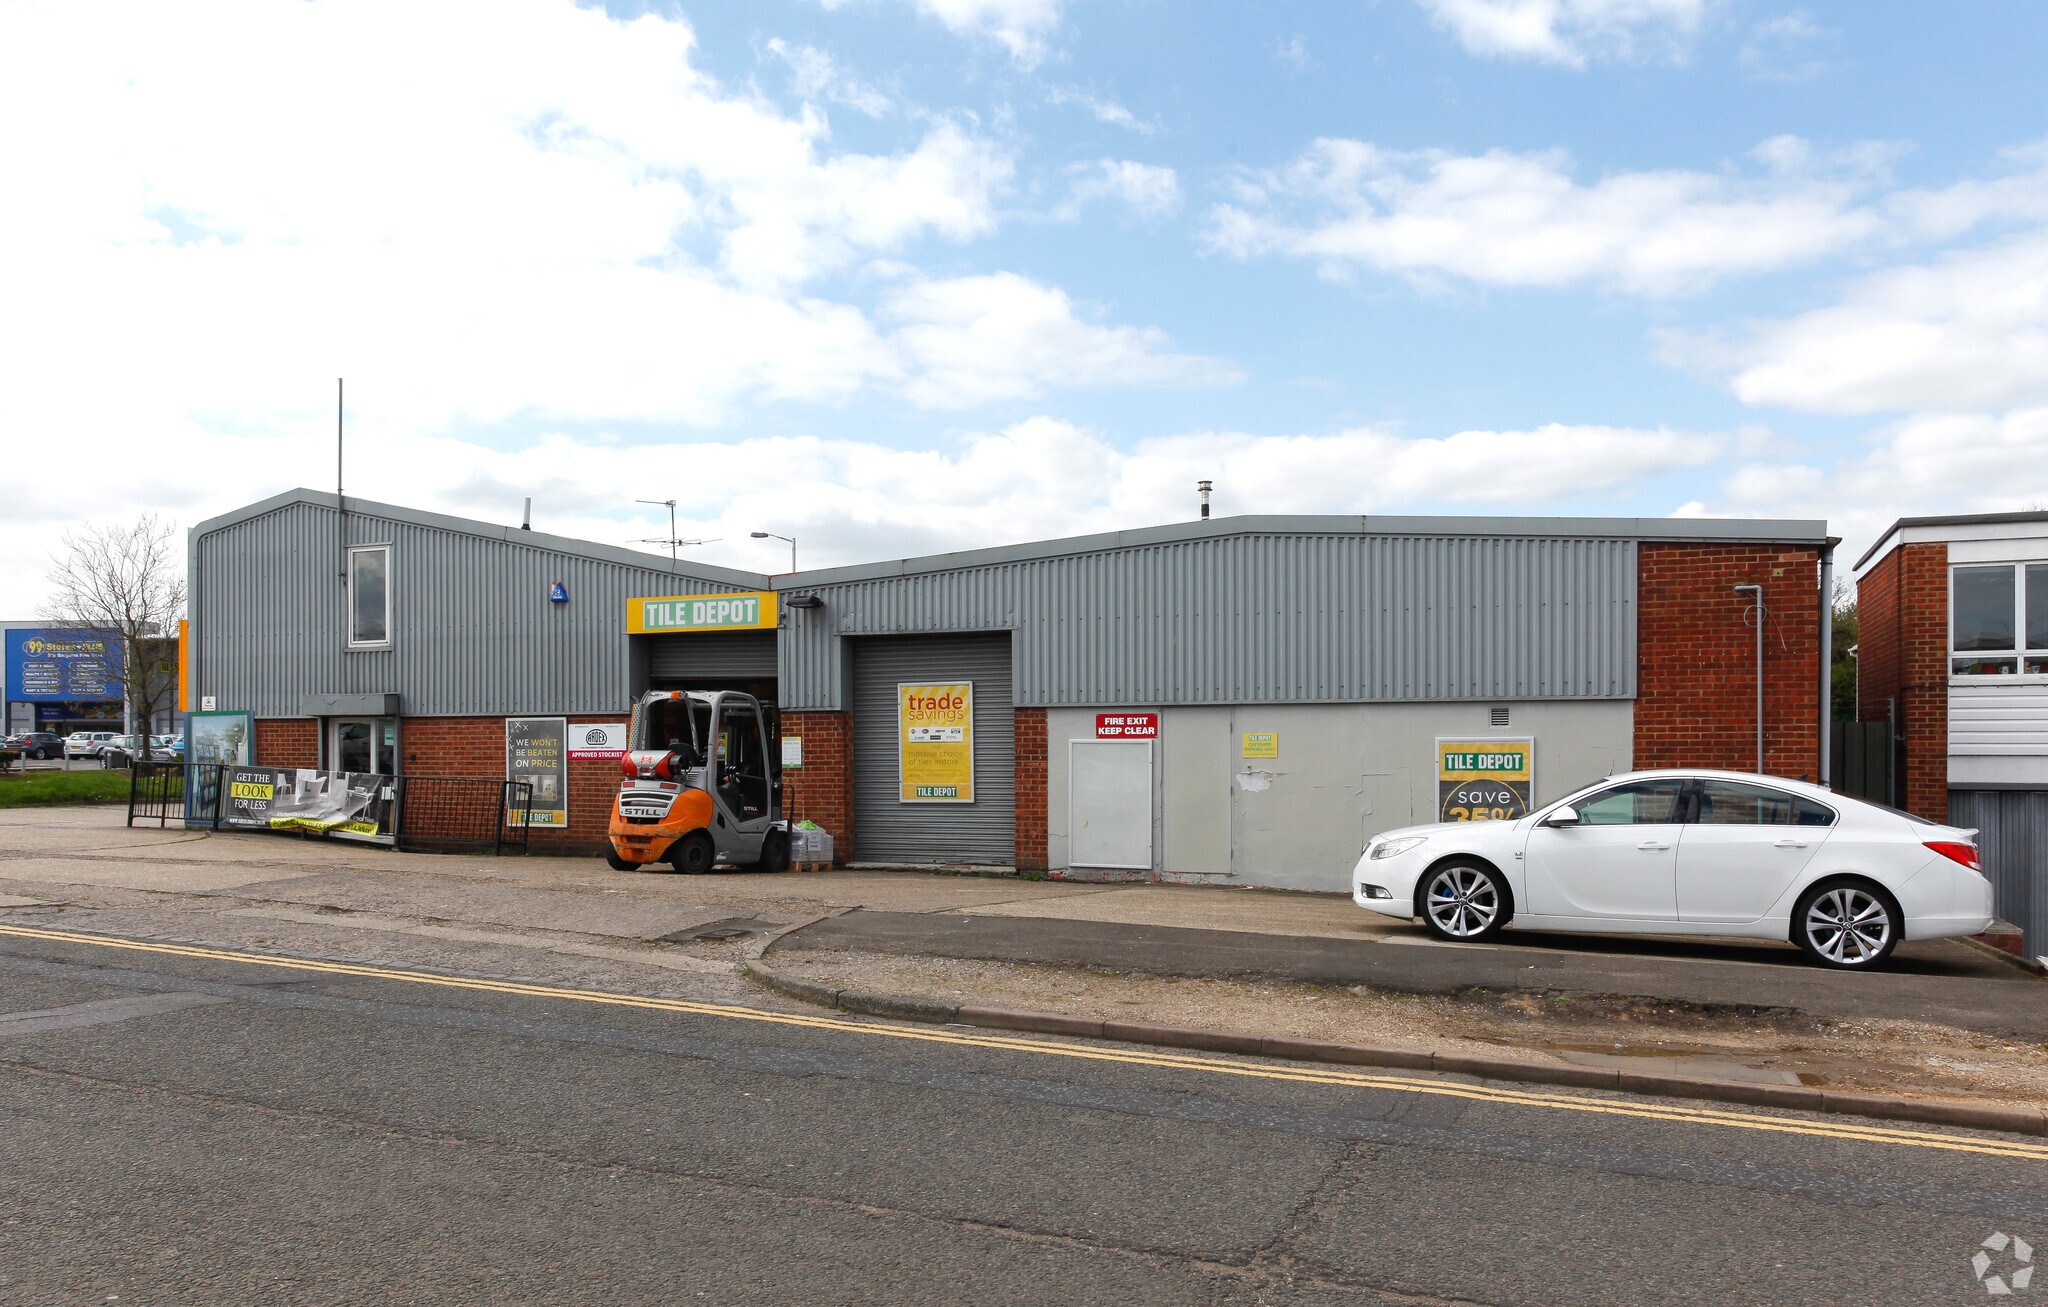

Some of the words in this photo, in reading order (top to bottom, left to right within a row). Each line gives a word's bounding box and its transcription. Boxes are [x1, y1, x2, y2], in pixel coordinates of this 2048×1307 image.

[646, 602, 686, 627] TILE
[692, 599, 757, 624] DEPOT
[908, 693, 964, 711] trade
[908, 709, 964, 723] savings
[1105, 718, 1125, 726] FIRE
[1127, 717, 1149, 726] EXIT
[1098, 727, 1122, 736] KEEP
[1124, 726, 1156, 735] CLEAR
[515, 739, 530, 747] WE
[531, 738, 558, 747] WON'T
[515, 749, 526, 757] BE
[528, 749, 558, 757] BEATEN
[939, 750, 964, 758] choice
[515, 759, 529, 768] ON
[531, 759, 558, 768] PRICE
[908, 758, 916, 766] of
[1446, 754, 1474, 769] TILE
[1478, 754, 1521, 769] DEPOT
[236, 773, 252, 782] GET
[253, 773, 271, 783] THE
[235, 784, 269, 798] LOOK
[917, 787, 932, 796] TILE
[933, 787, 956, 796] DEPOT
[1458, 791, 1511, 804] save
[234, 799, 249, 809] FOR
[250, 800, 267, 810] LESS
[624, 808, 661, 816] STILL
[521, 813, 533, 822] TIE
[534, 813, 553, 822] DEPOT
